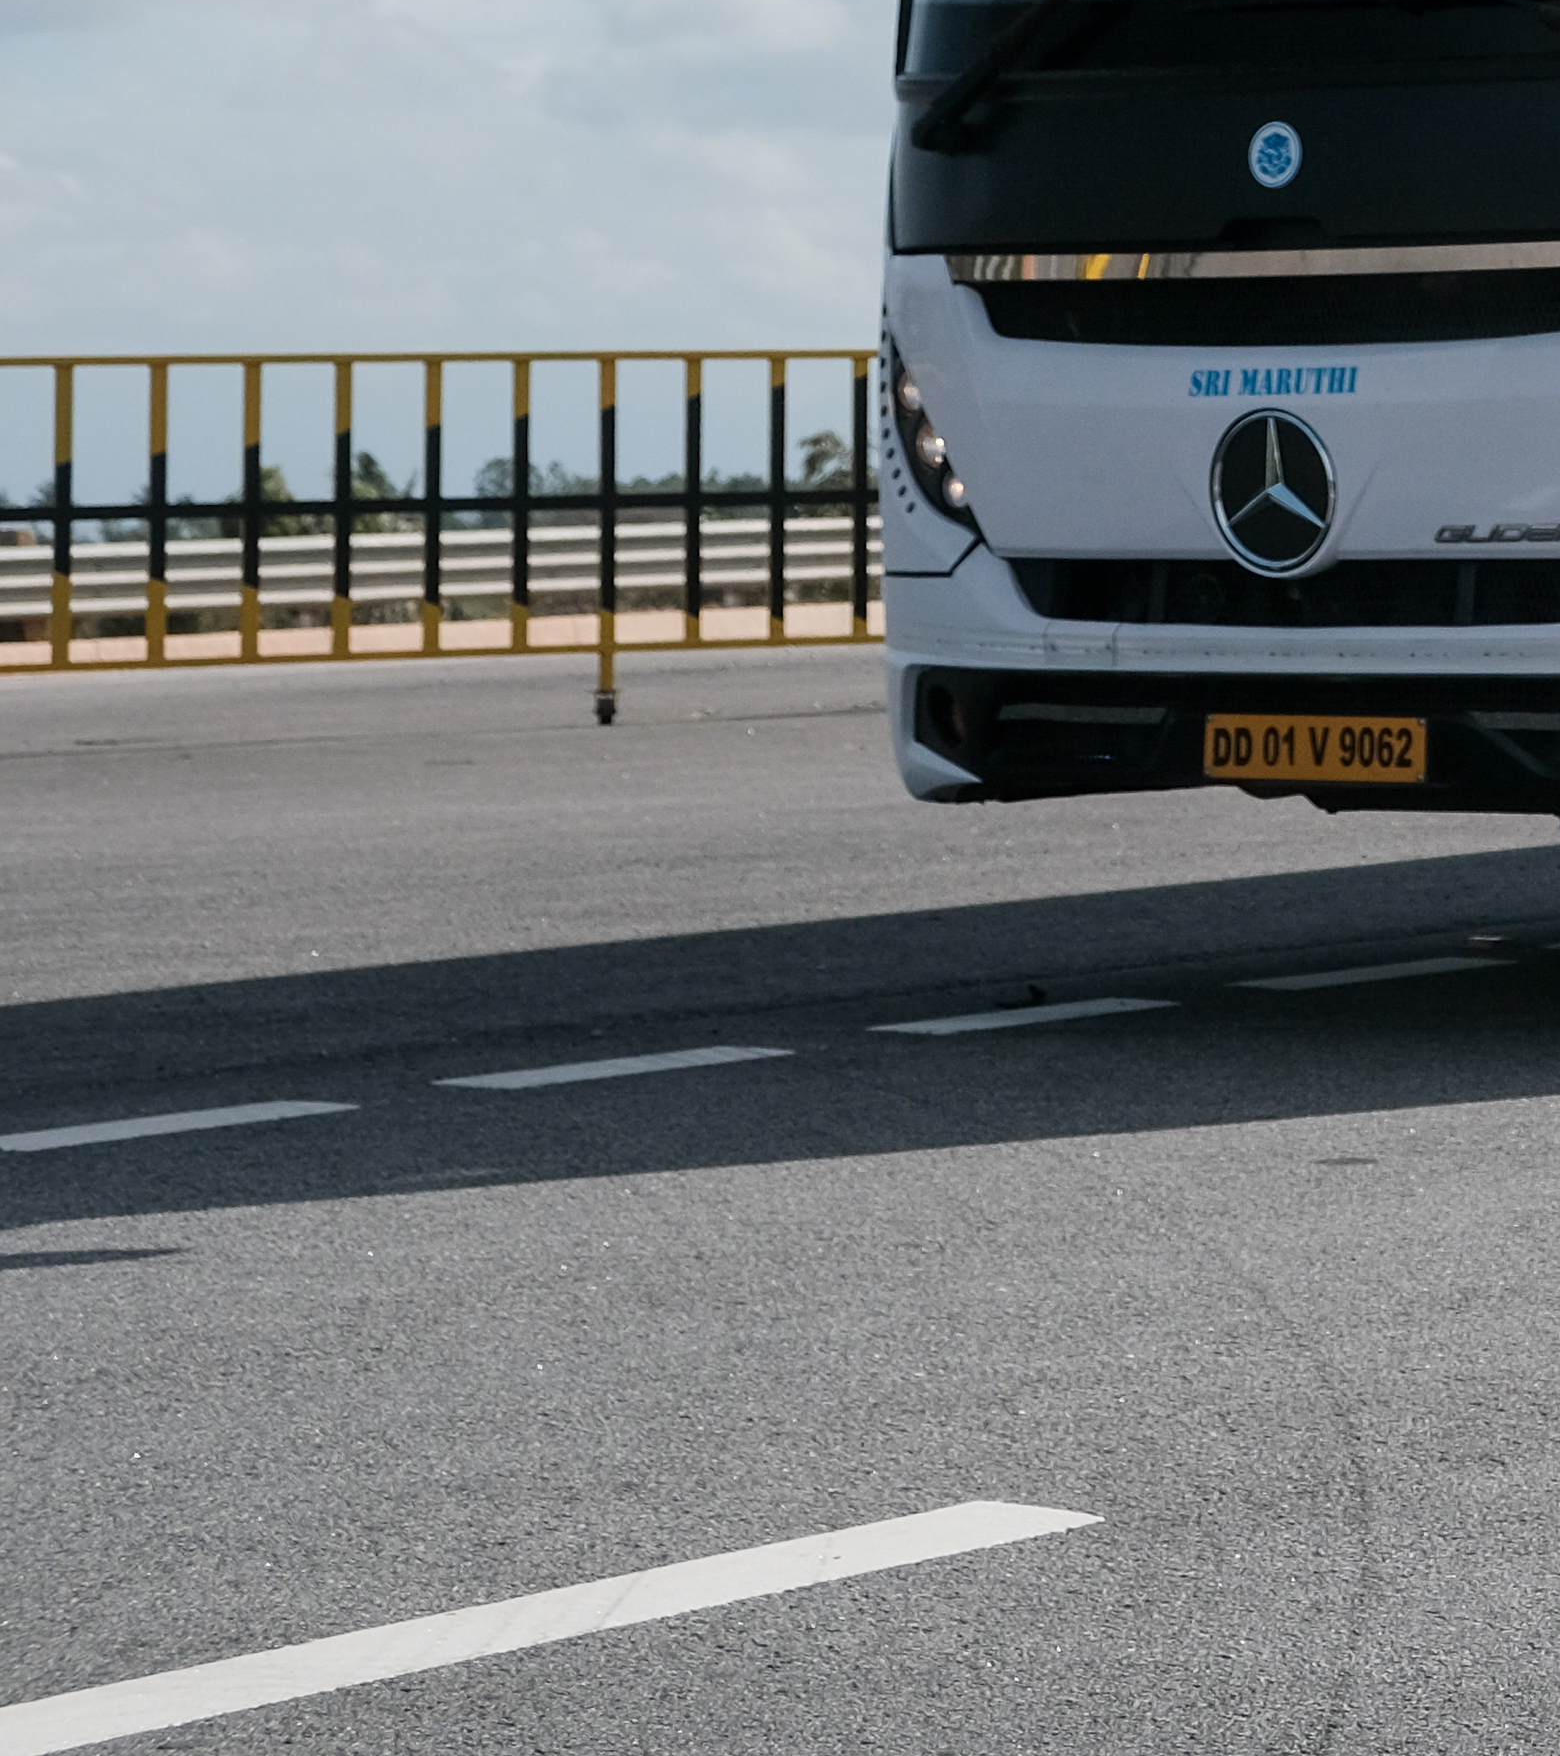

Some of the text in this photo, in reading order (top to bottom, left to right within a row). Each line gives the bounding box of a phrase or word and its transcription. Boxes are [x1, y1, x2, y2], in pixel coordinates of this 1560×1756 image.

[1189, 366, 1358, 396] SRI MARUTHI
[1213, 726, 1413, 768] DD 01 V 9062
